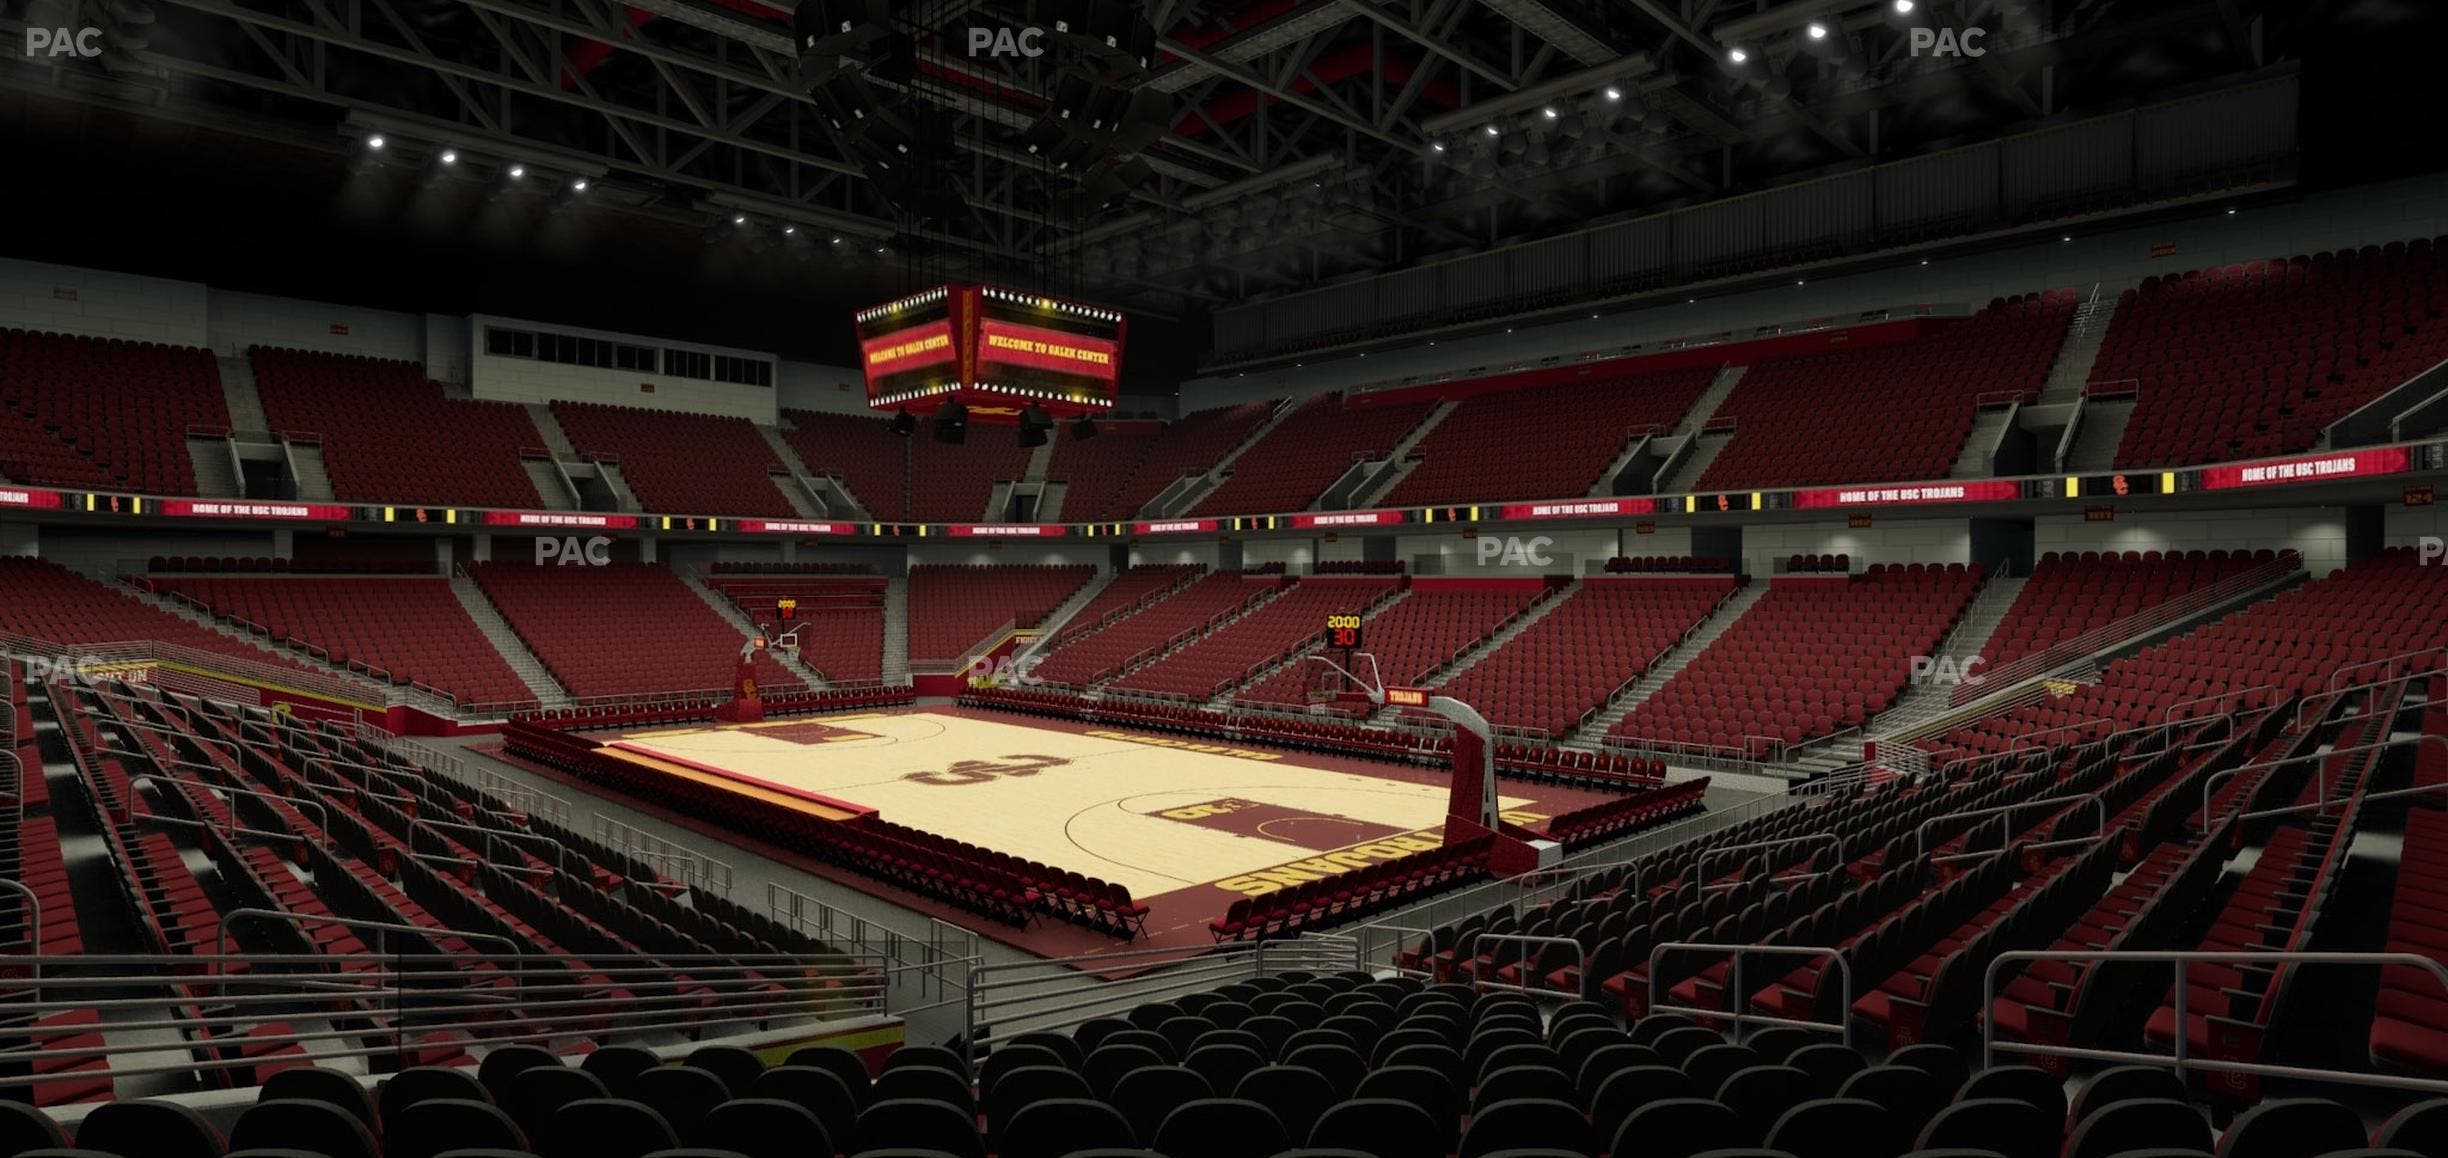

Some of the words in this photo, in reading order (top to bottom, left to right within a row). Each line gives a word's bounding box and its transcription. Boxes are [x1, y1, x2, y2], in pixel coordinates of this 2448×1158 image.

[989, 335, 1033, 351] WELCOME
[1035, 342, 1047, 354] TO
[1048, 345, 1076, 358] GALEN
[1077, 349, 1108, 364] CENTER
[2242, 467, 2265, 481] HOME
[2266, 466, 2277, 480] OF
[2278, 464, 2295, 478] THE
[2296, 462, 2314, 476] USC
[2314, 457, 2355, 474] TROJANS
[1840, 491, 1866, 502] HOME
[1867, 491, 1880, 501] OF
[1881, 489, 1899, 500] THE
[1900, 488, 1920, 500] USC
[1920, 487, 1964, 499] TROJANS
[192, 504, 219, 514] HOME
[220, 504, 232, 514] OF
[233, 505, 250, 514] THE
[252, 505, 269, 515] USC
[271, 506, 308, 516] TROJANS
[1328, 615, 1360, 629] 20:00
[1335, 629, 1355, 645] 30
